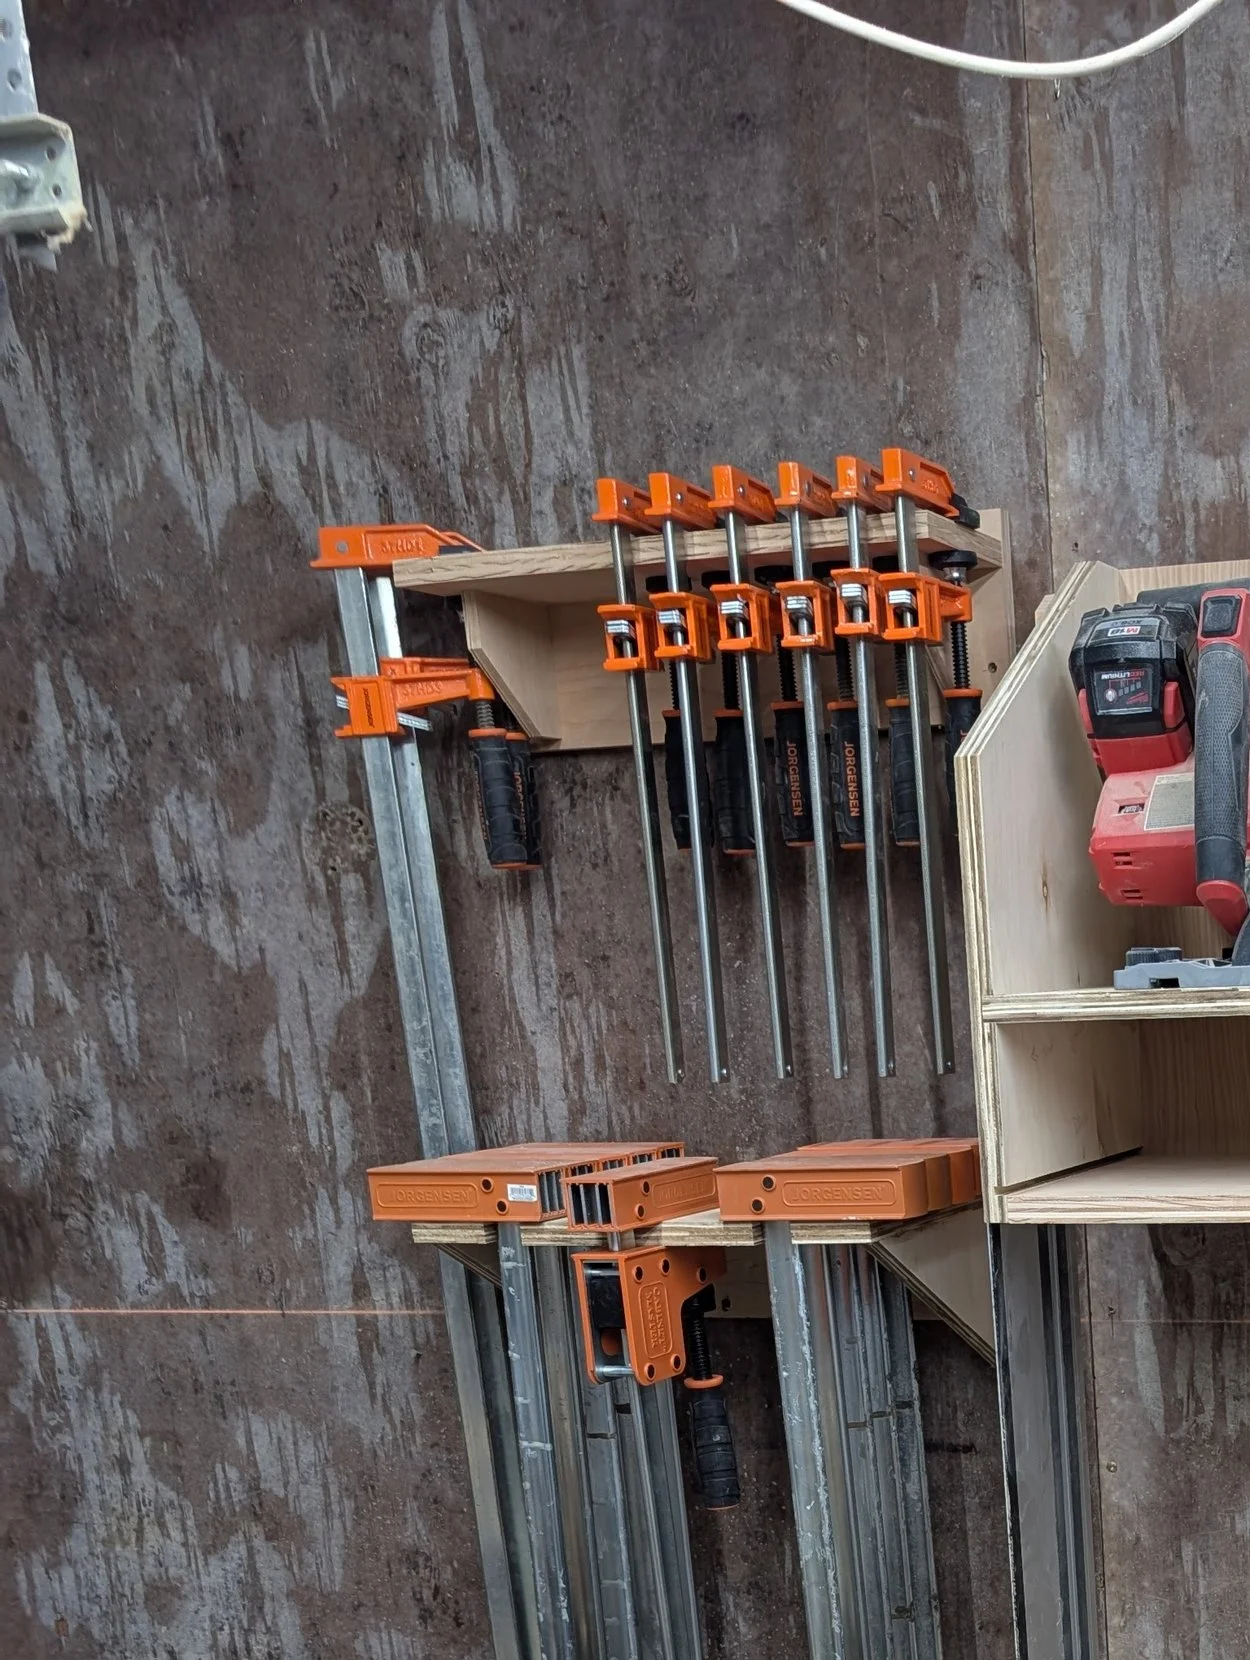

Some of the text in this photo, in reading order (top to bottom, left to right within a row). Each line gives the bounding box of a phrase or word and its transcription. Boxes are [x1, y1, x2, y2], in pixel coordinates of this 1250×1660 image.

[786, 741, 802, 817] JORGENSEN
[844, 741, 860, 817] JORGENSEN
[392, 1188, 470, 1203] JORGENSEN
[790, 1186, 883, 1202] JORGENSEN
